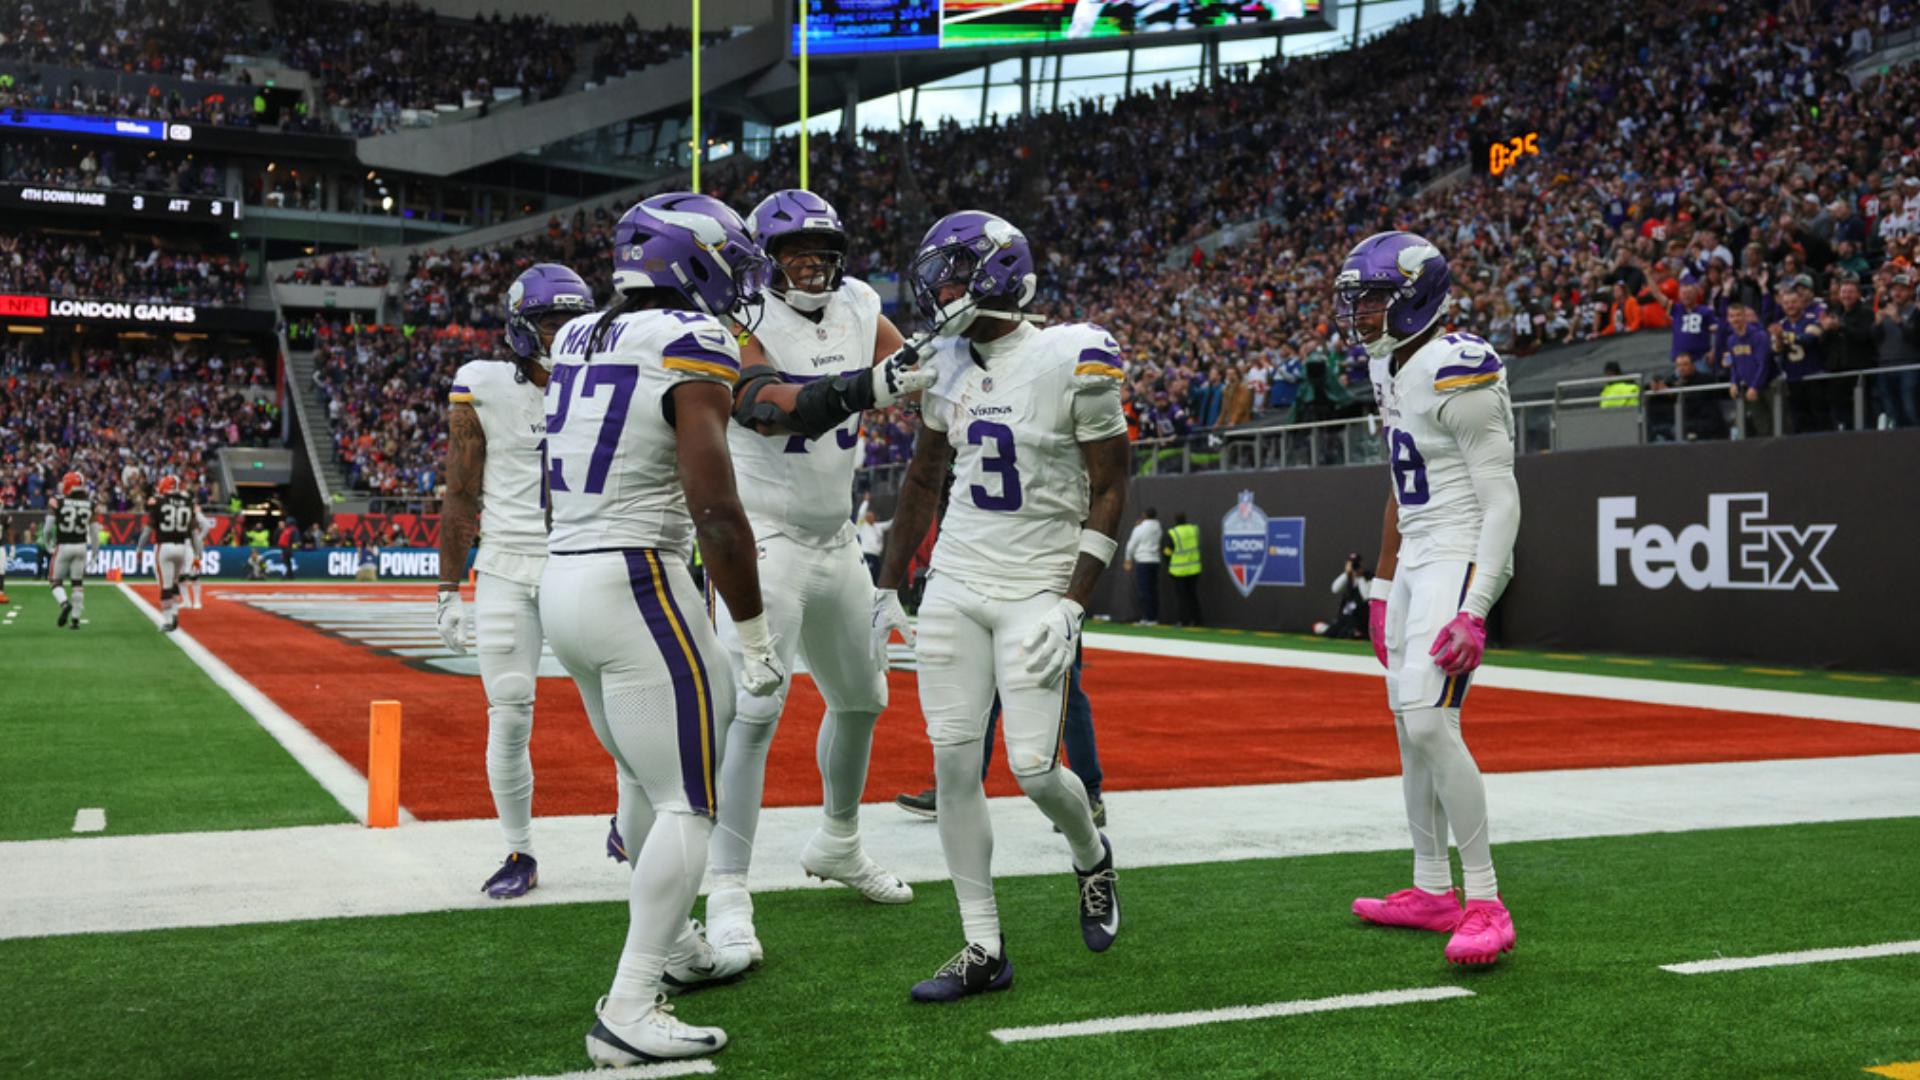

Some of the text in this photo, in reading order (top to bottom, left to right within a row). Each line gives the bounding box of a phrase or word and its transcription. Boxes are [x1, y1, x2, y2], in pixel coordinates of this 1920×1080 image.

[1489, 132, 1539, 175] 0:25
[21, 188, 106, 206] 4TH DOWN MADE
[132, 196, 143, 210] 3
[168, 199, 190, 212] ATT
[210, 201, 222, 215] 3
[8, 299, 42, 314] NFL
[50, 300, 196, 323] LONDON GAMES
[545, 364, 639, 494] 27
[968, 419, 1022, 511] 3
[1383, 426, 1431, 505] 8
[60, 506, 92, 533] 33
[159, 504, 192, 532] 30
[1597, 491, 1840, 592] FedEx
[328, 552, 361, 576] CHA
